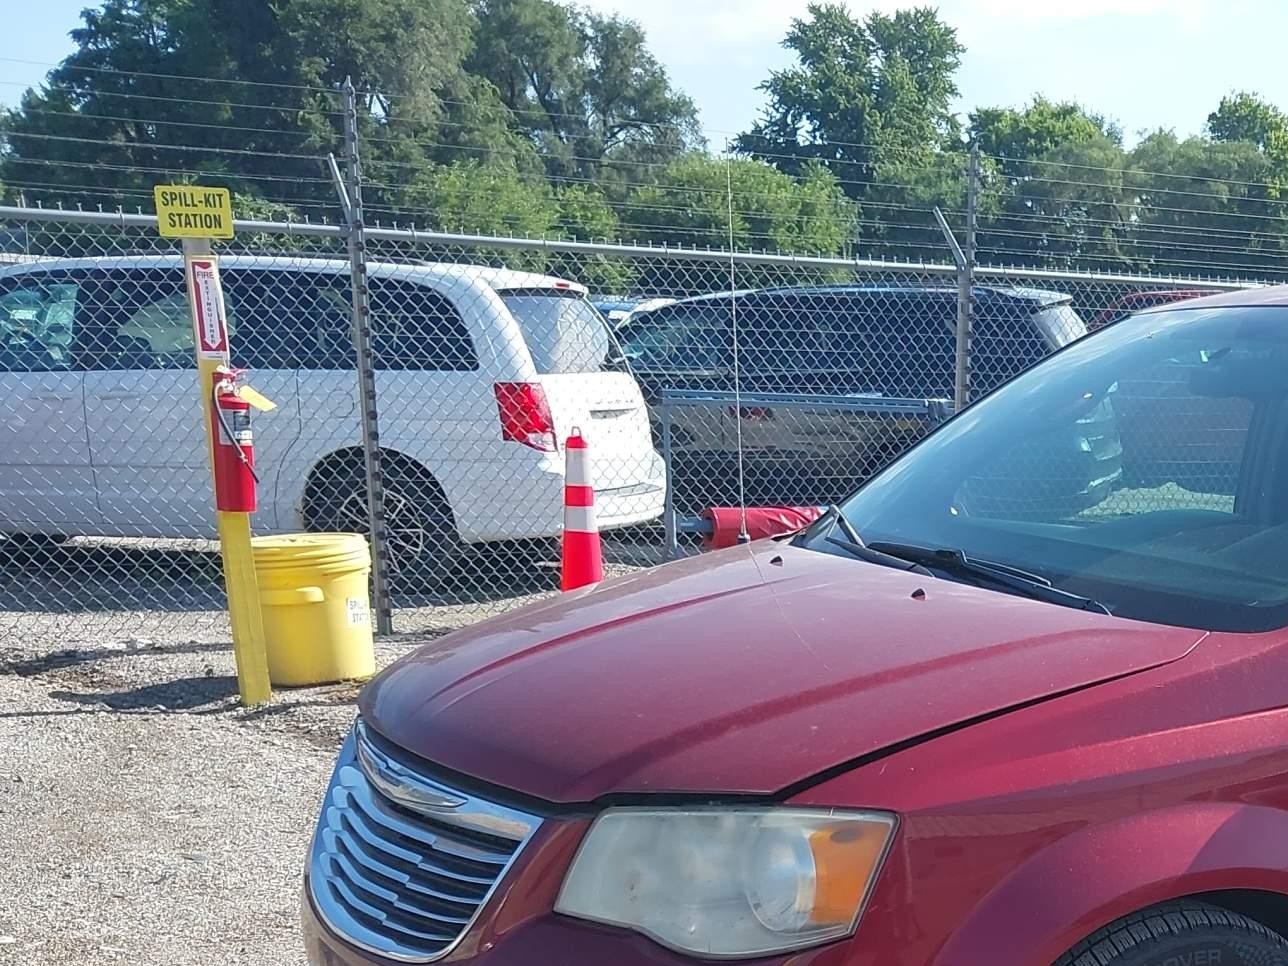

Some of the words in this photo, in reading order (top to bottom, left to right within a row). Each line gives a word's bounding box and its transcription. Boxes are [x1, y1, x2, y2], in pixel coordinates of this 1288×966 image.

[160, 190, 224, 209] SPILL-KIT
[168, 212, 222, 229] STATION
[196, 271, 215, 279] FIRE
[203, 280, 216, 344] EXTINGUISHER
